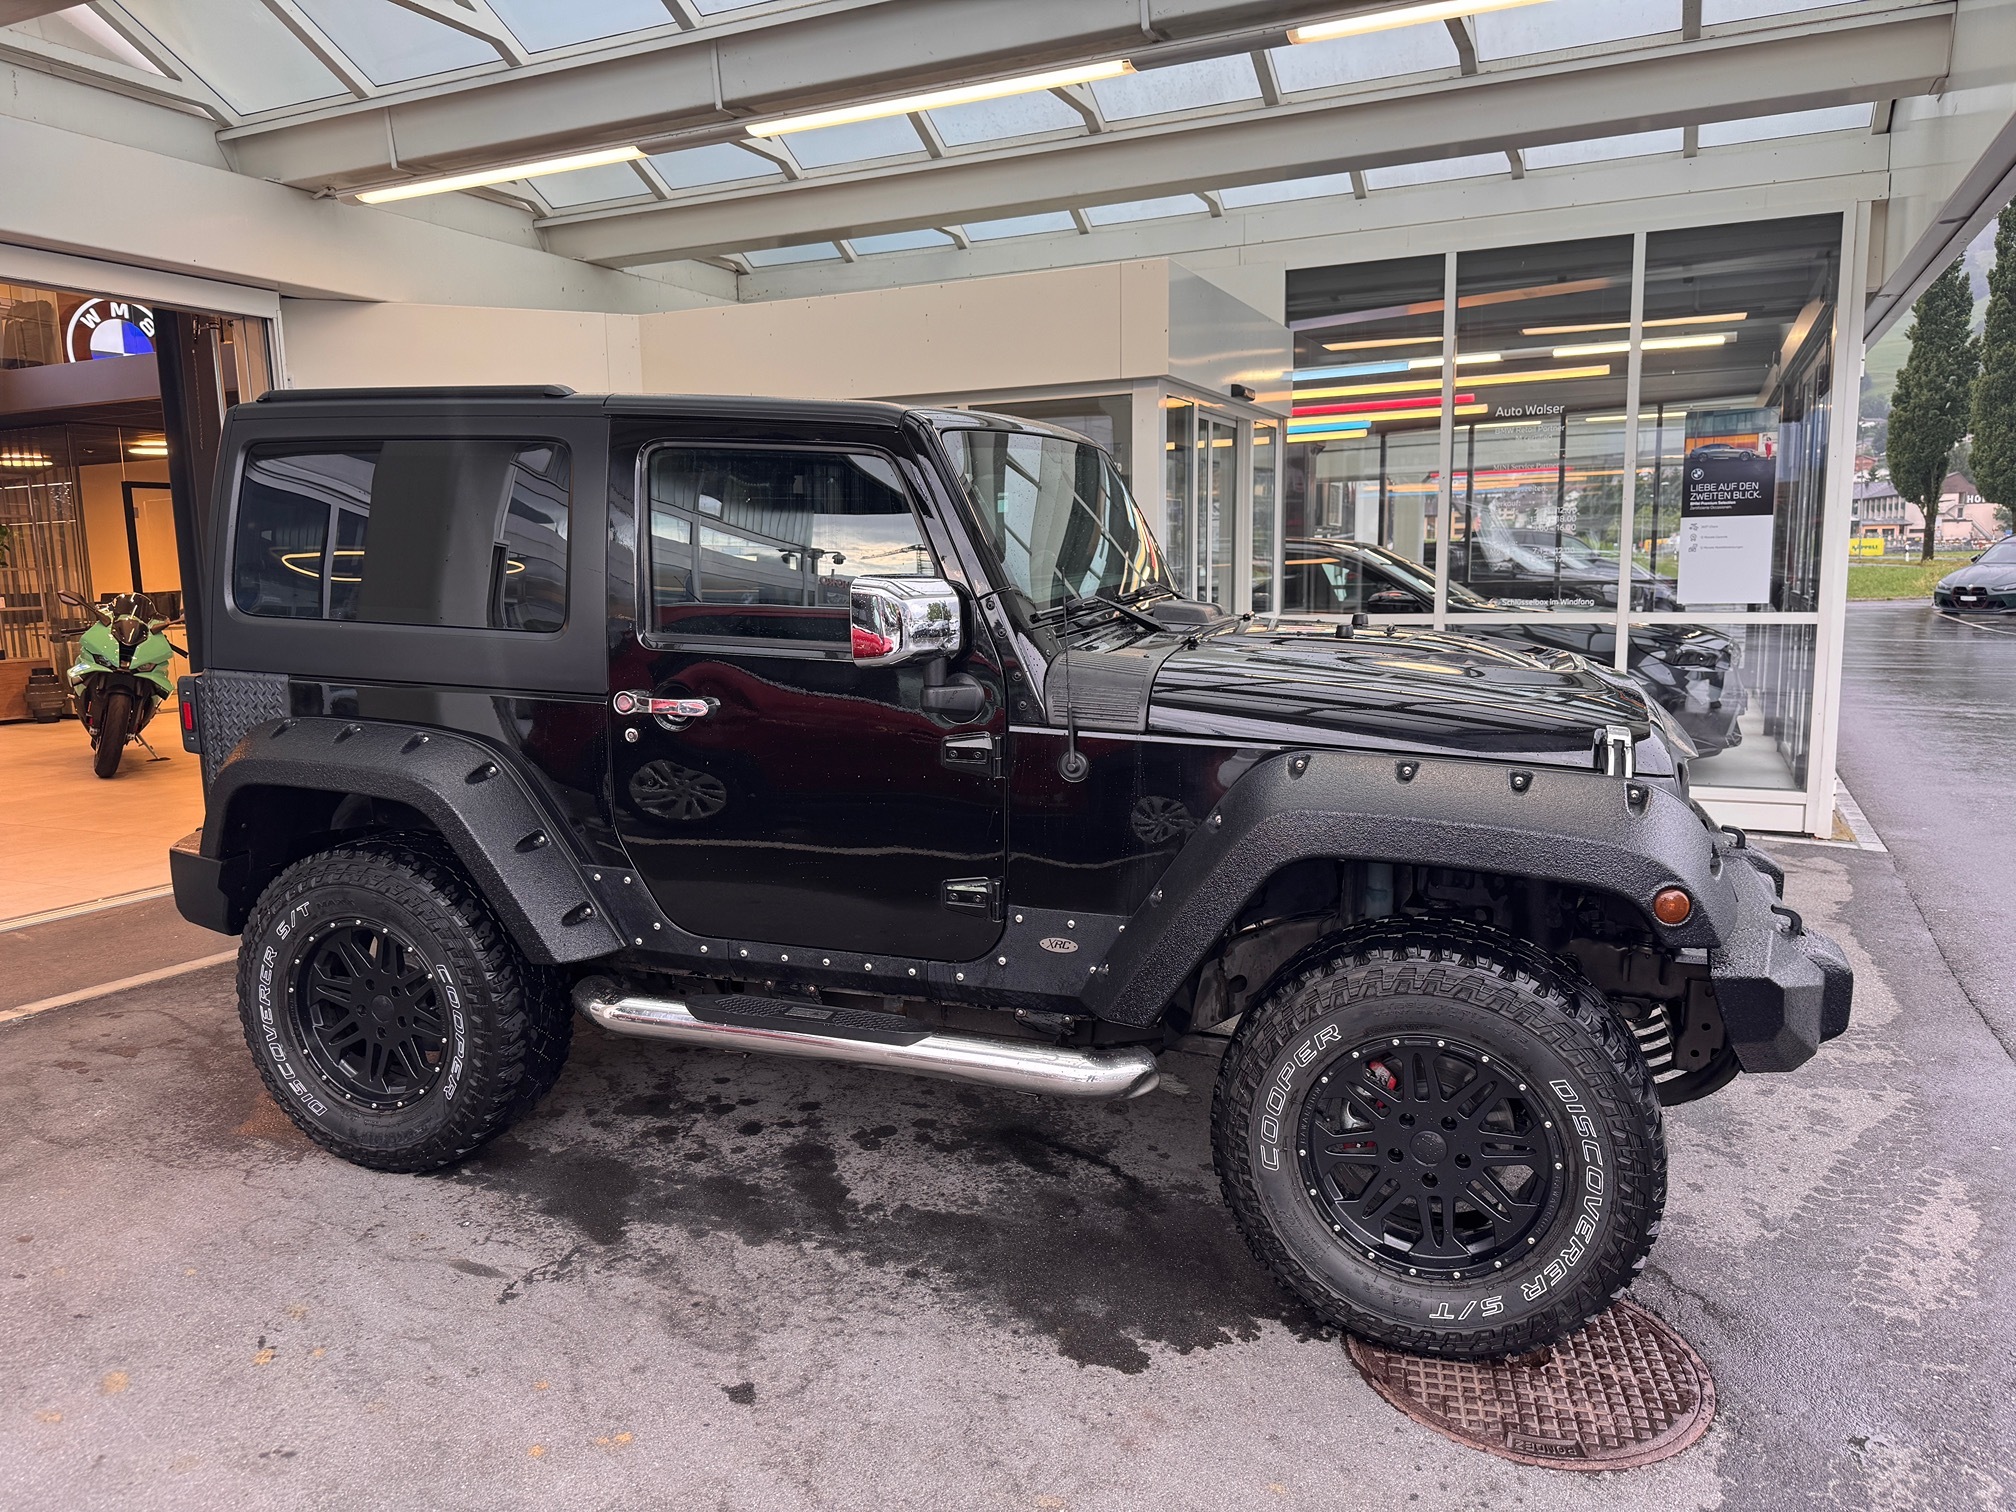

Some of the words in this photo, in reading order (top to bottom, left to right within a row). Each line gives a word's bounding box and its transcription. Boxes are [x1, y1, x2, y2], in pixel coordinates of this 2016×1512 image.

[1495, 406, 1523, 417] Auto
[1525, 404, 1565, 415] Walser
[1537, 424, 1565, 432] Partner
[1690, 483, 1717, 492] LIEBE
[1717, 482, 1738, 491] AUF
[1739, 481, 1759, 490] DEN
[1690, 491, 1731, 501] ZWEITEN
[1732, 490, 1762, 500] BLICK.
[1502, 598, 1549, 606] Schlüsselbox
[1560, 597, 1595, 607] Windfang
[275, 901, 311, 941] S/T
[1047, 938, 1072, 950] XRC
[258, 945, 328, 1117] DISCOVERER
[436, 964, 466, 1101] COOPER
[1260, 1022, 1343, 1172] COOPER
[1519, 1078, 1606, 1303] DISCOVERER
[1428, 1294, 1505, 1321] S/T
